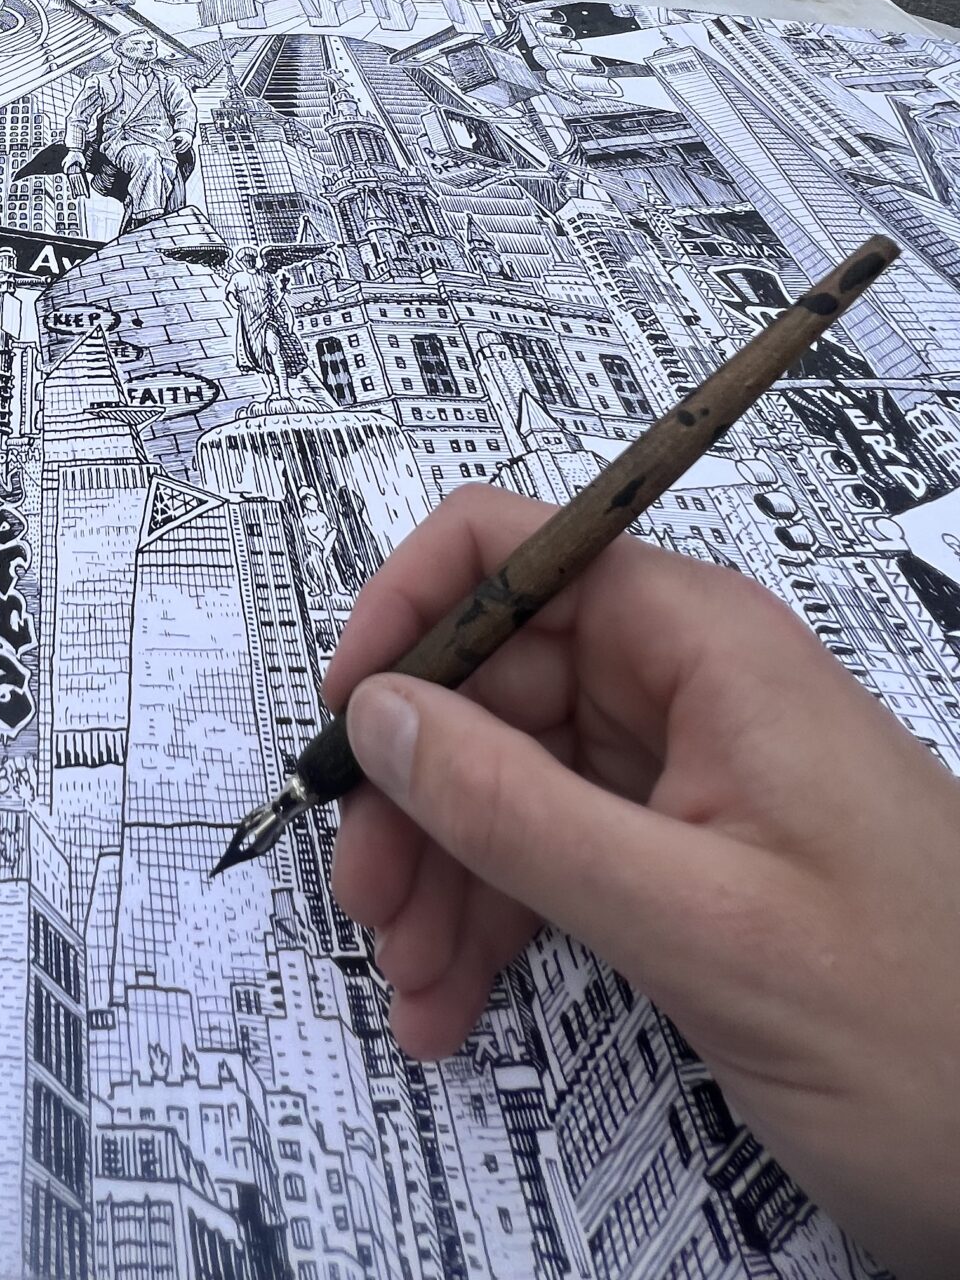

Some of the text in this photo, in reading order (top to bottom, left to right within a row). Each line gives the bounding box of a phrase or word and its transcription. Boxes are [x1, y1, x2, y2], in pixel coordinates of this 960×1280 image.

[684, 242, 701, 254] E
[53, 312, 101, 328] KEEP
[128, 386, 205, 405] FAITH
